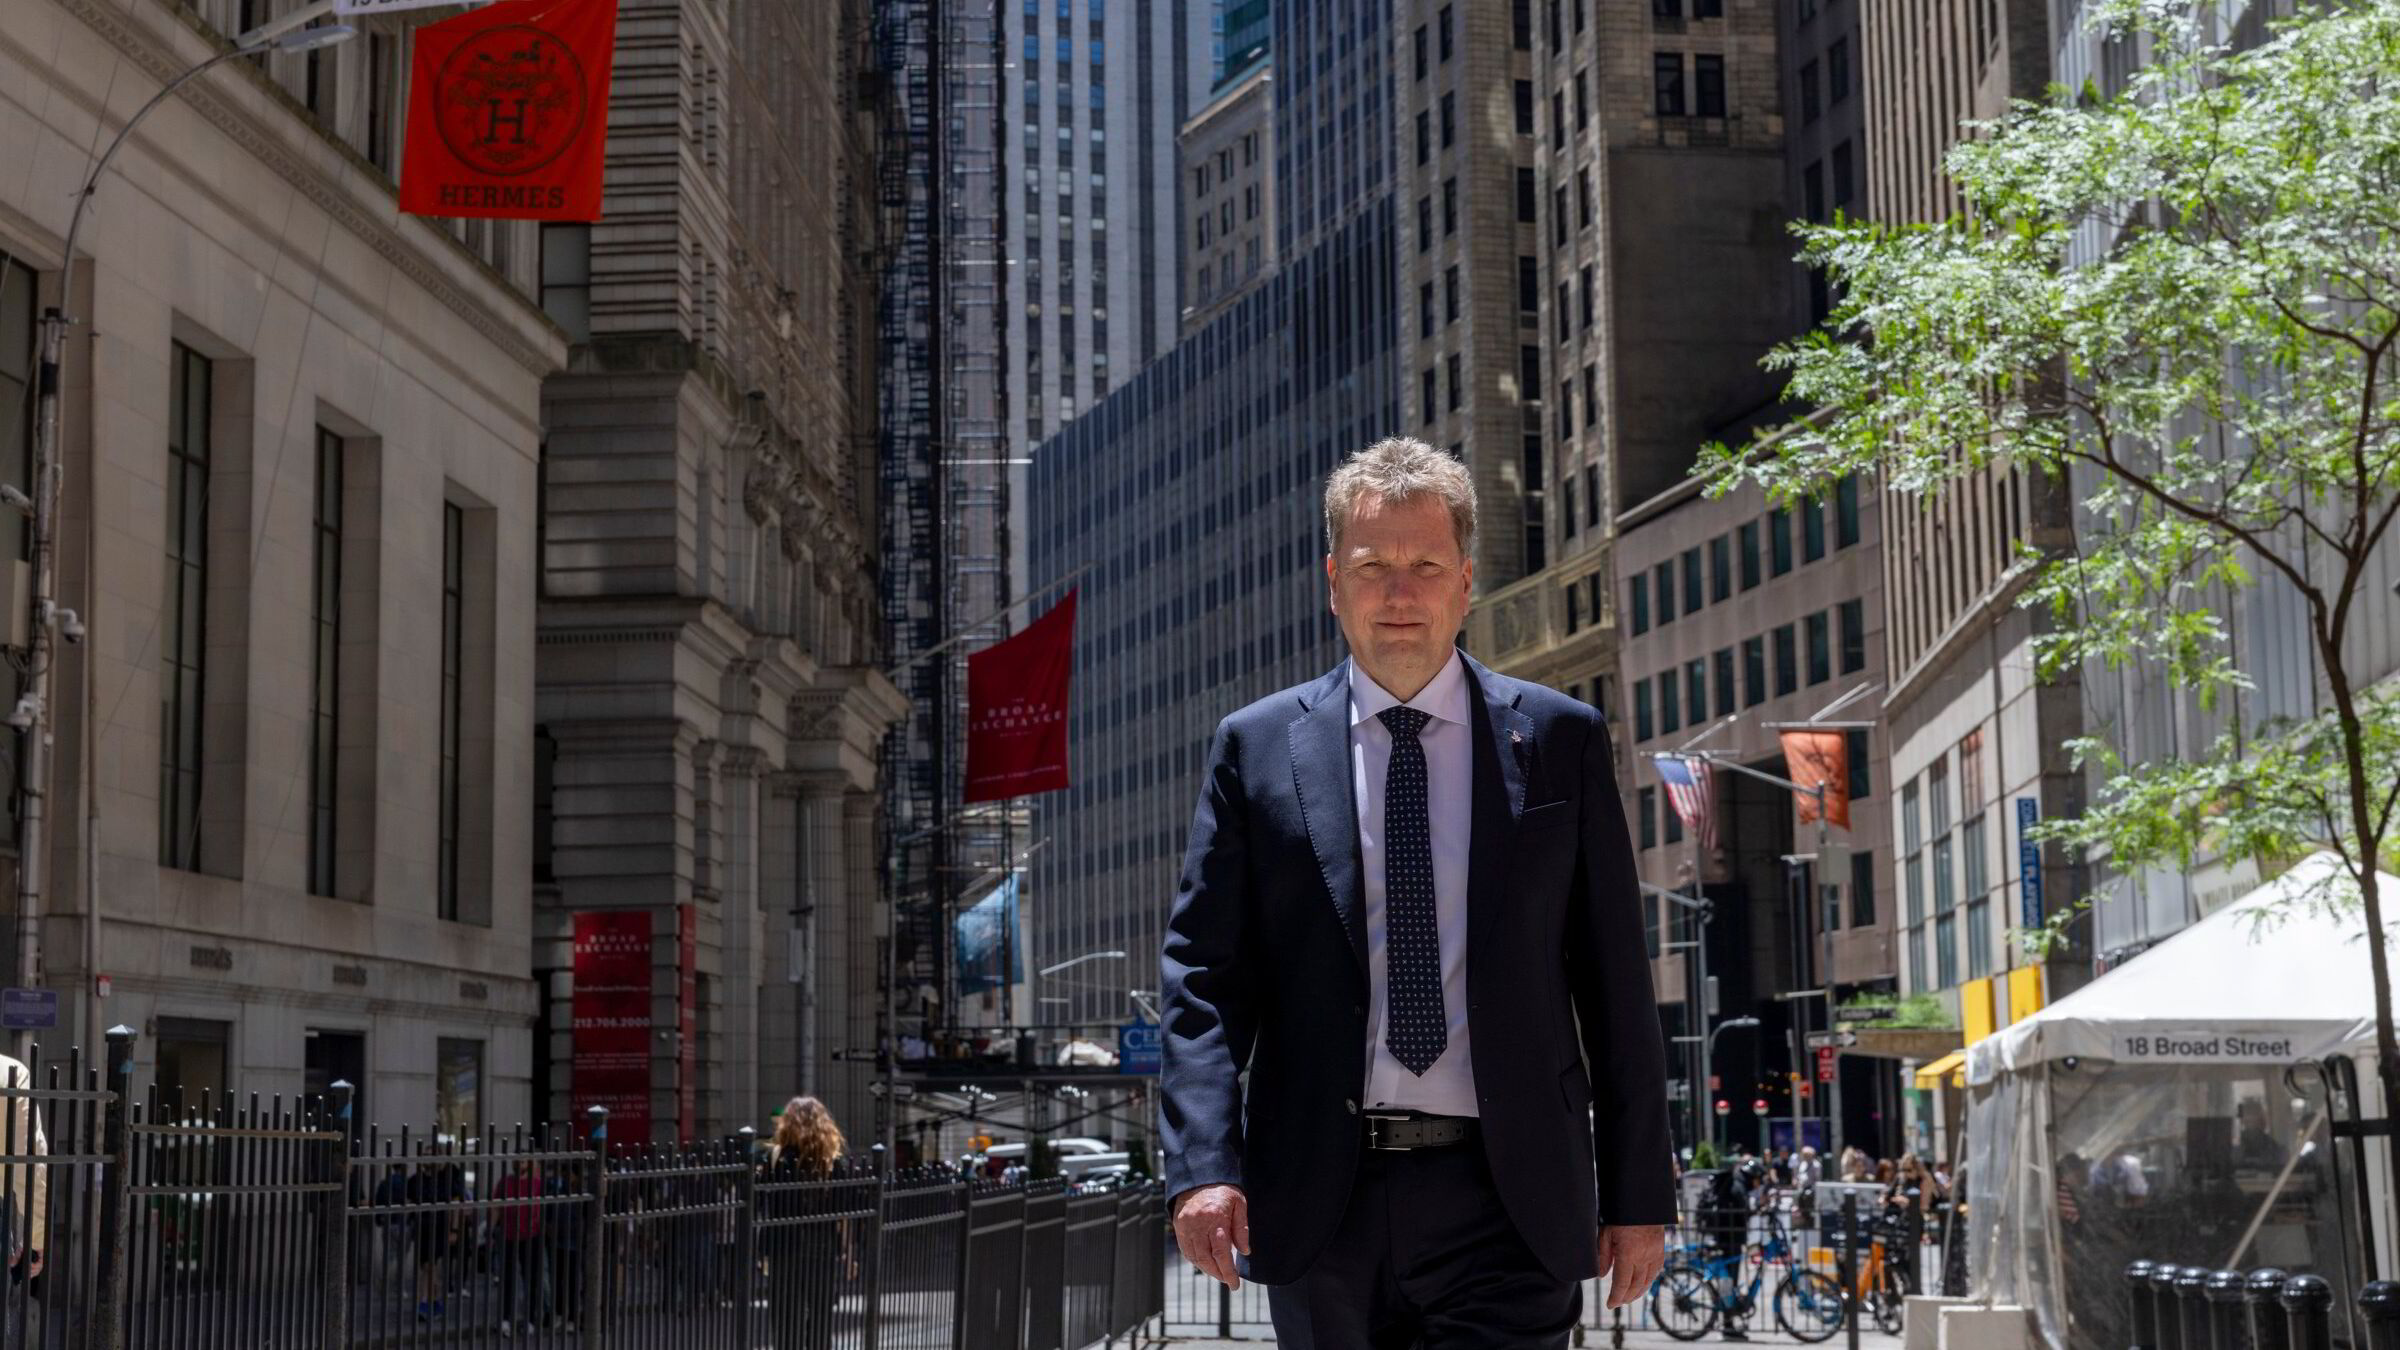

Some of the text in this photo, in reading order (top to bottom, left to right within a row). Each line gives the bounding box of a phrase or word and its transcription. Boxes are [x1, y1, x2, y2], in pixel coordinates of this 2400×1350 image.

[484, 98, 528, 144] H
[2125, 1037, 2292, 1056] 18 Broad Street
